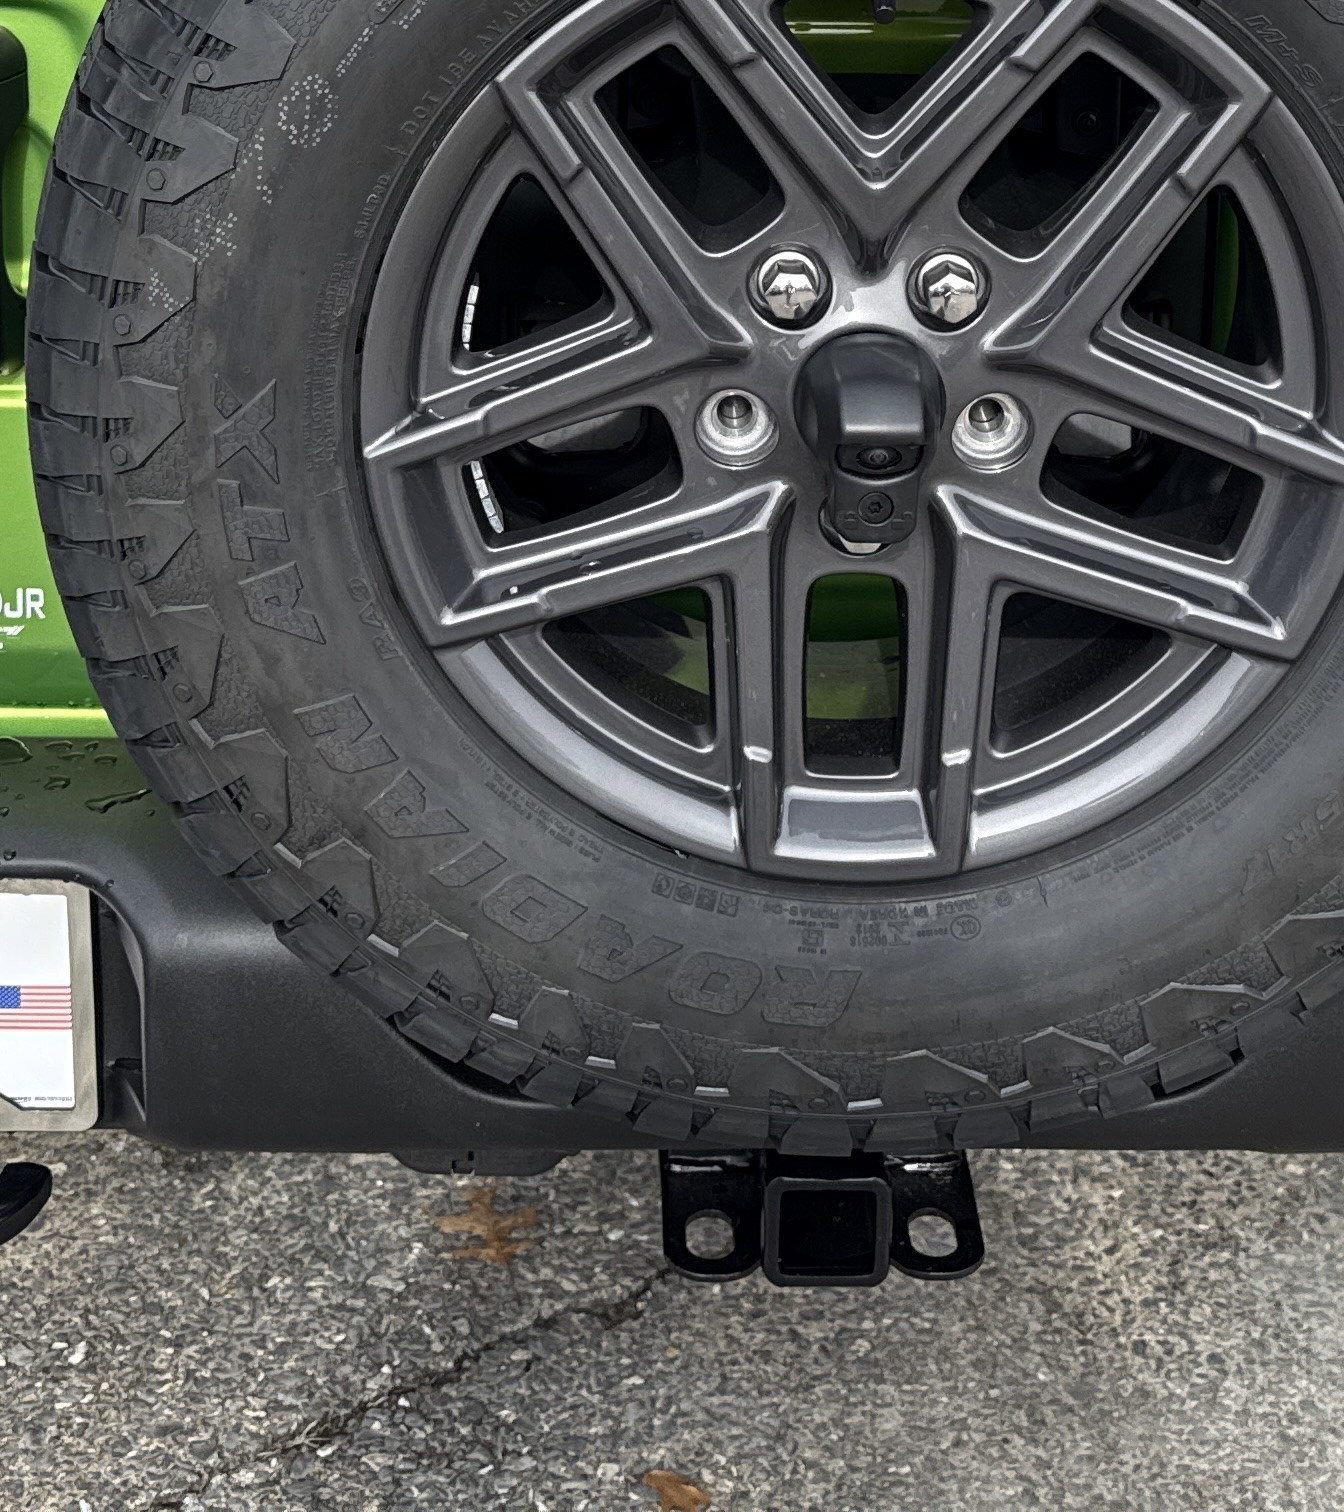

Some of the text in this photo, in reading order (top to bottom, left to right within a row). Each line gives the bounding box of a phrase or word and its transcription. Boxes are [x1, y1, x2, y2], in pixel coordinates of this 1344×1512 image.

[399, 87, 440, 139] DOT
[1243, 2, 1324, 95] M+S
[212, 378, 326, 644] ATX
[294, 696, 862, 1025] ROADIAN
